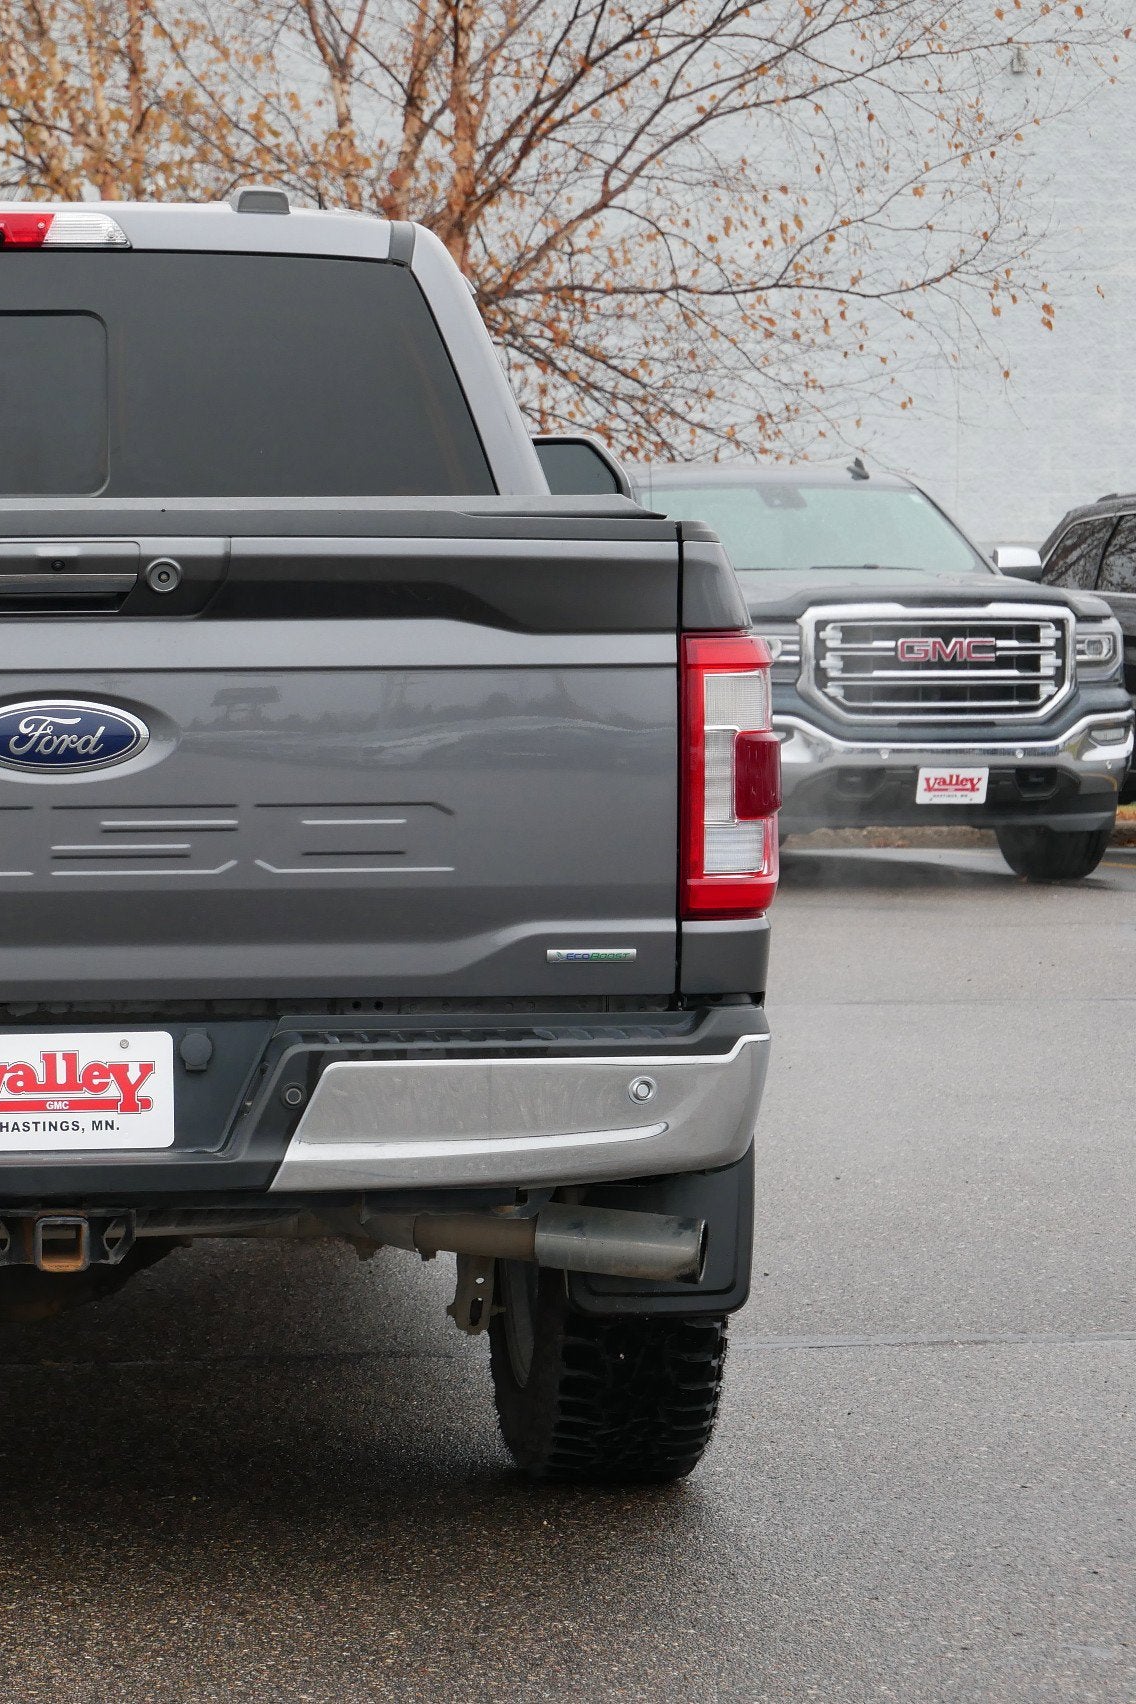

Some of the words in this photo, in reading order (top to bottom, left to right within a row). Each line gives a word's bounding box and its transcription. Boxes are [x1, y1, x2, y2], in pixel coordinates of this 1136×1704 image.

[898, 637, 996, 662] GMC
[9, 715, 105, 755] Ford
[924, 774, 982, 793] Valley
[46, 1101, 70, 1110] GMC
[0, 1120, 86, 1133] HASTINGS,
[91, 1119, 120, 1131] MN.
